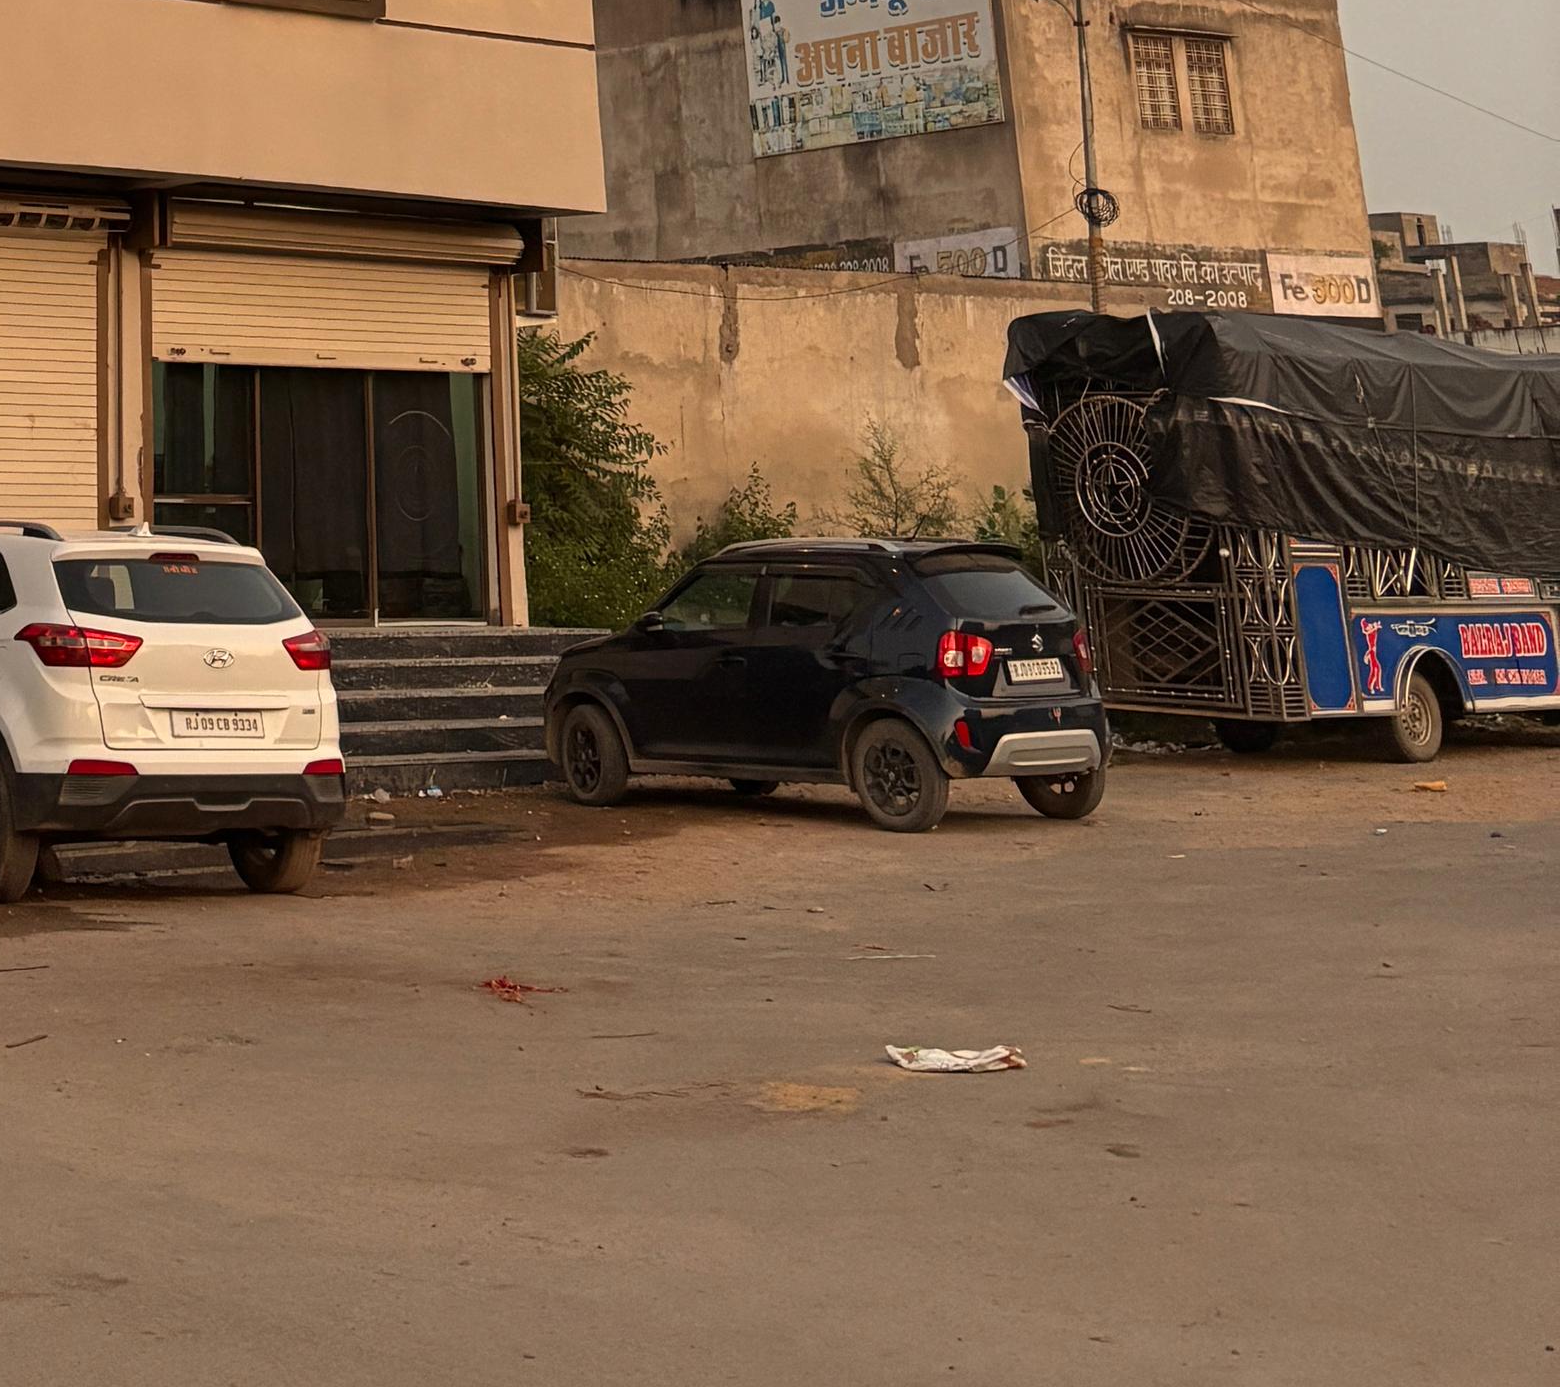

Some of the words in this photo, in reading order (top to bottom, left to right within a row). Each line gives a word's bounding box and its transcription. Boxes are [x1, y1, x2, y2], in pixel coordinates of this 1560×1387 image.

[794, 29, 882, 87] अपना
[883, 11, 981, 71] बाजार
[1046, 246, 1088, 281] जिंदल
[1124, 259, 1149, 281] एण्ड
[1150, 259, 1181, 284] पावर
[1220, 262, 1262, 291] उत्पाद
[1166, 288, 1248, 308] 208-2008
[1280, 273, 1309, 302] Fe
[186, 717, 199, 731] RJ
[201, 717, 213, 731] 09
[217, 717, 231, 731] CB
[232, 718, 258, 732] 9334
